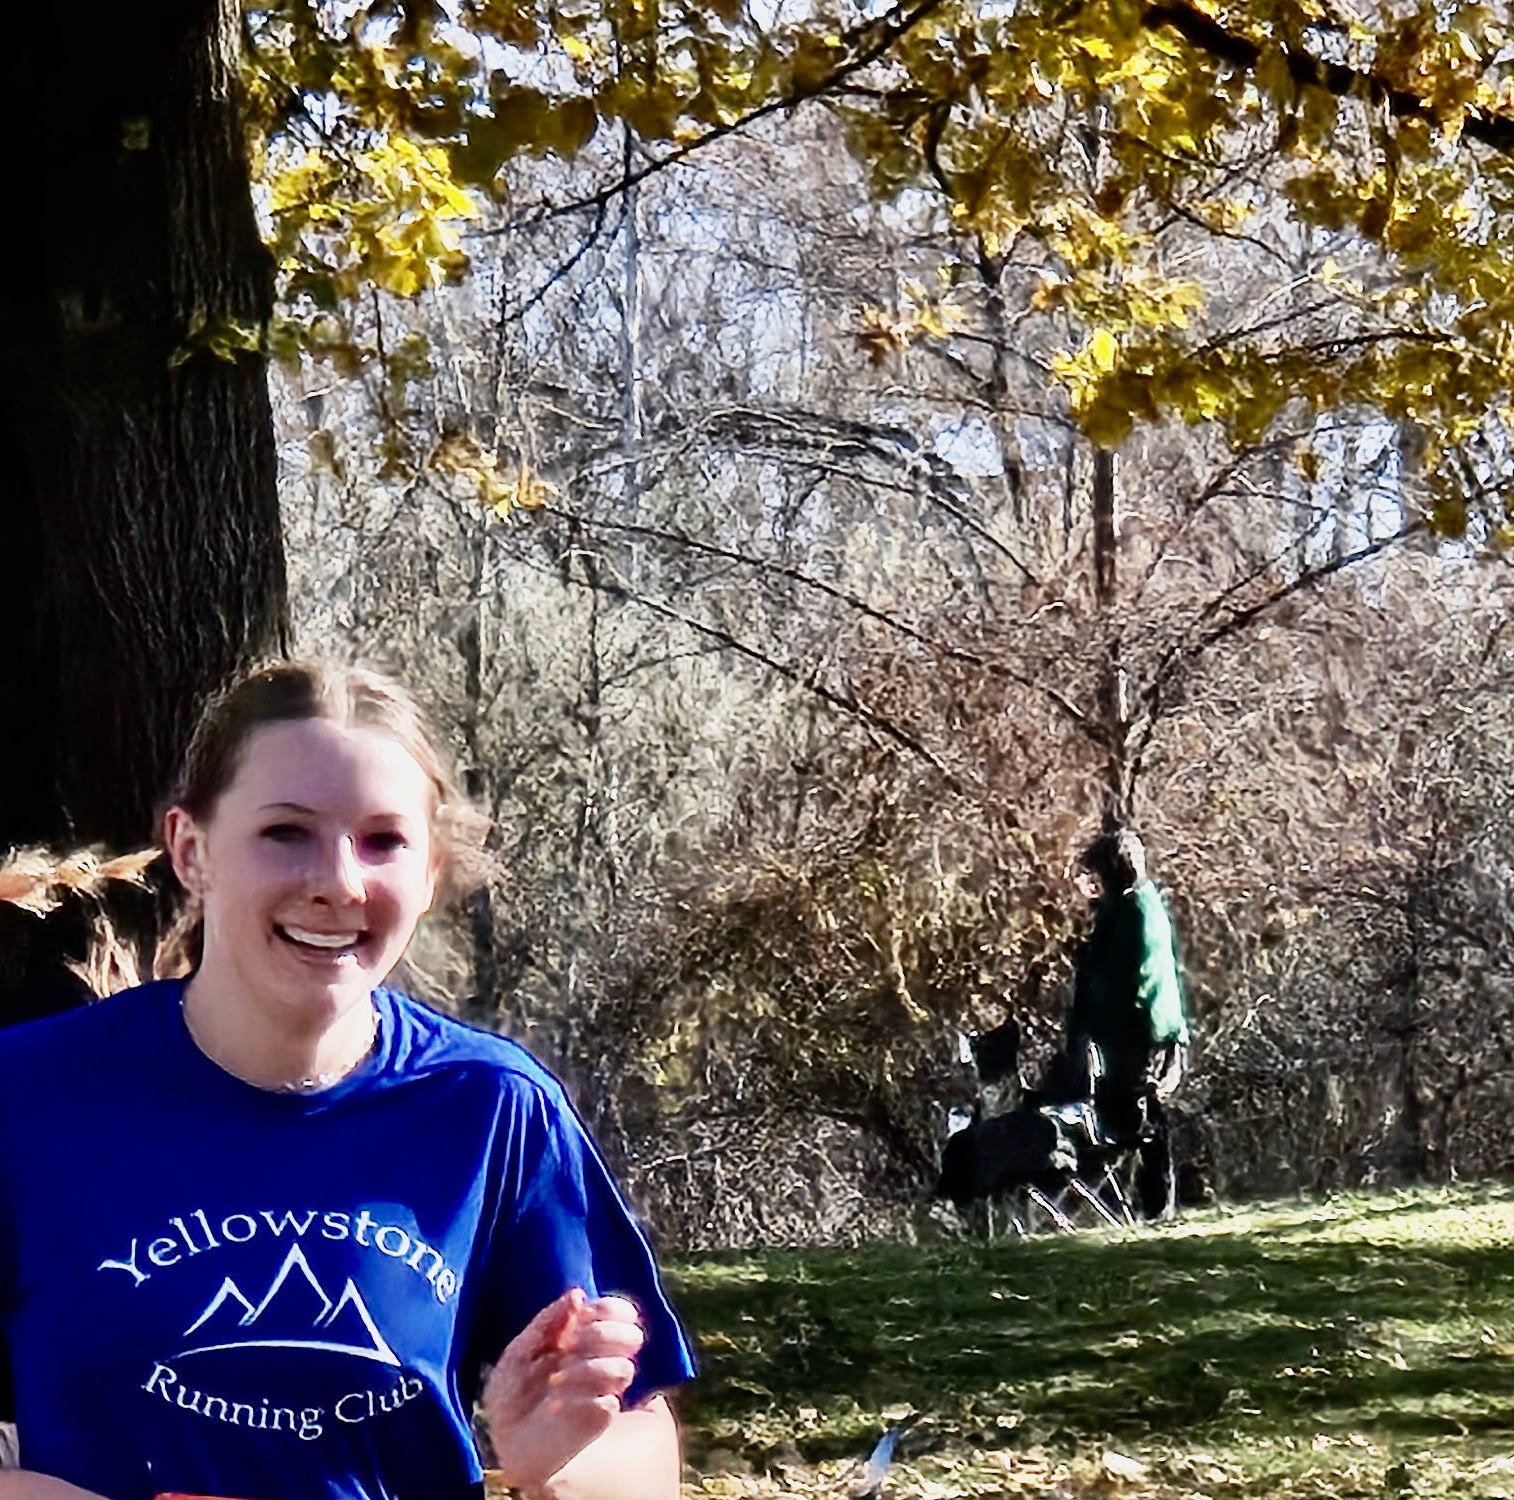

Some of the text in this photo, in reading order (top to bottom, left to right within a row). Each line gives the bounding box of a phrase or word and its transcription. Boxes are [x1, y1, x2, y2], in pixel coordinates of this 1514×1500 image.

[97, 1208, 459, 1304] Yellowstone
[140, 1360, 424, 1441] Running Club
